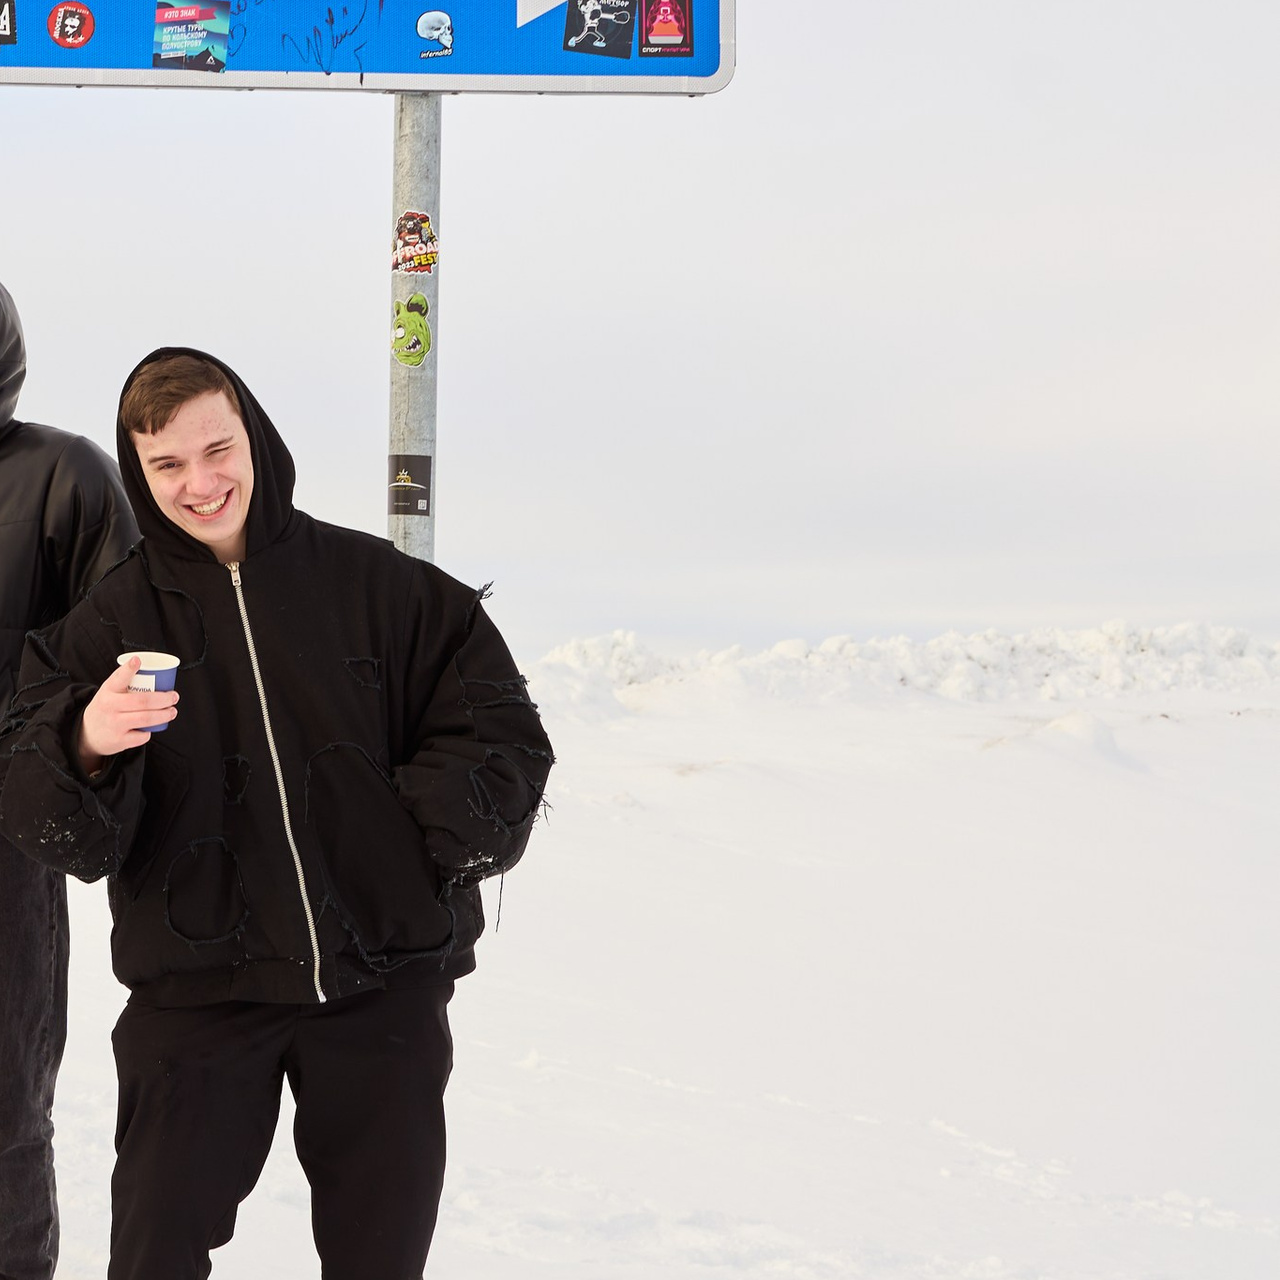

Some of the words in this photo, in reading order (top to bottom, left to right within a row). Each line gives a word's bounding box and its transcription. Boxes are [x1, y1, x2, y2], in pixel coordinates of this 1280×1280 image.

[180, 9, 196, 18] ЗНАК
[163, 25, 187, 34] КРУТЫЕ
[187, 23, 204, 32] ТУРЫ
[162, 34, 171, 42] ПО
[172, 31, 208, 41] КОЛЬСКОМУ
[413, 252, 438, 267] FEST
